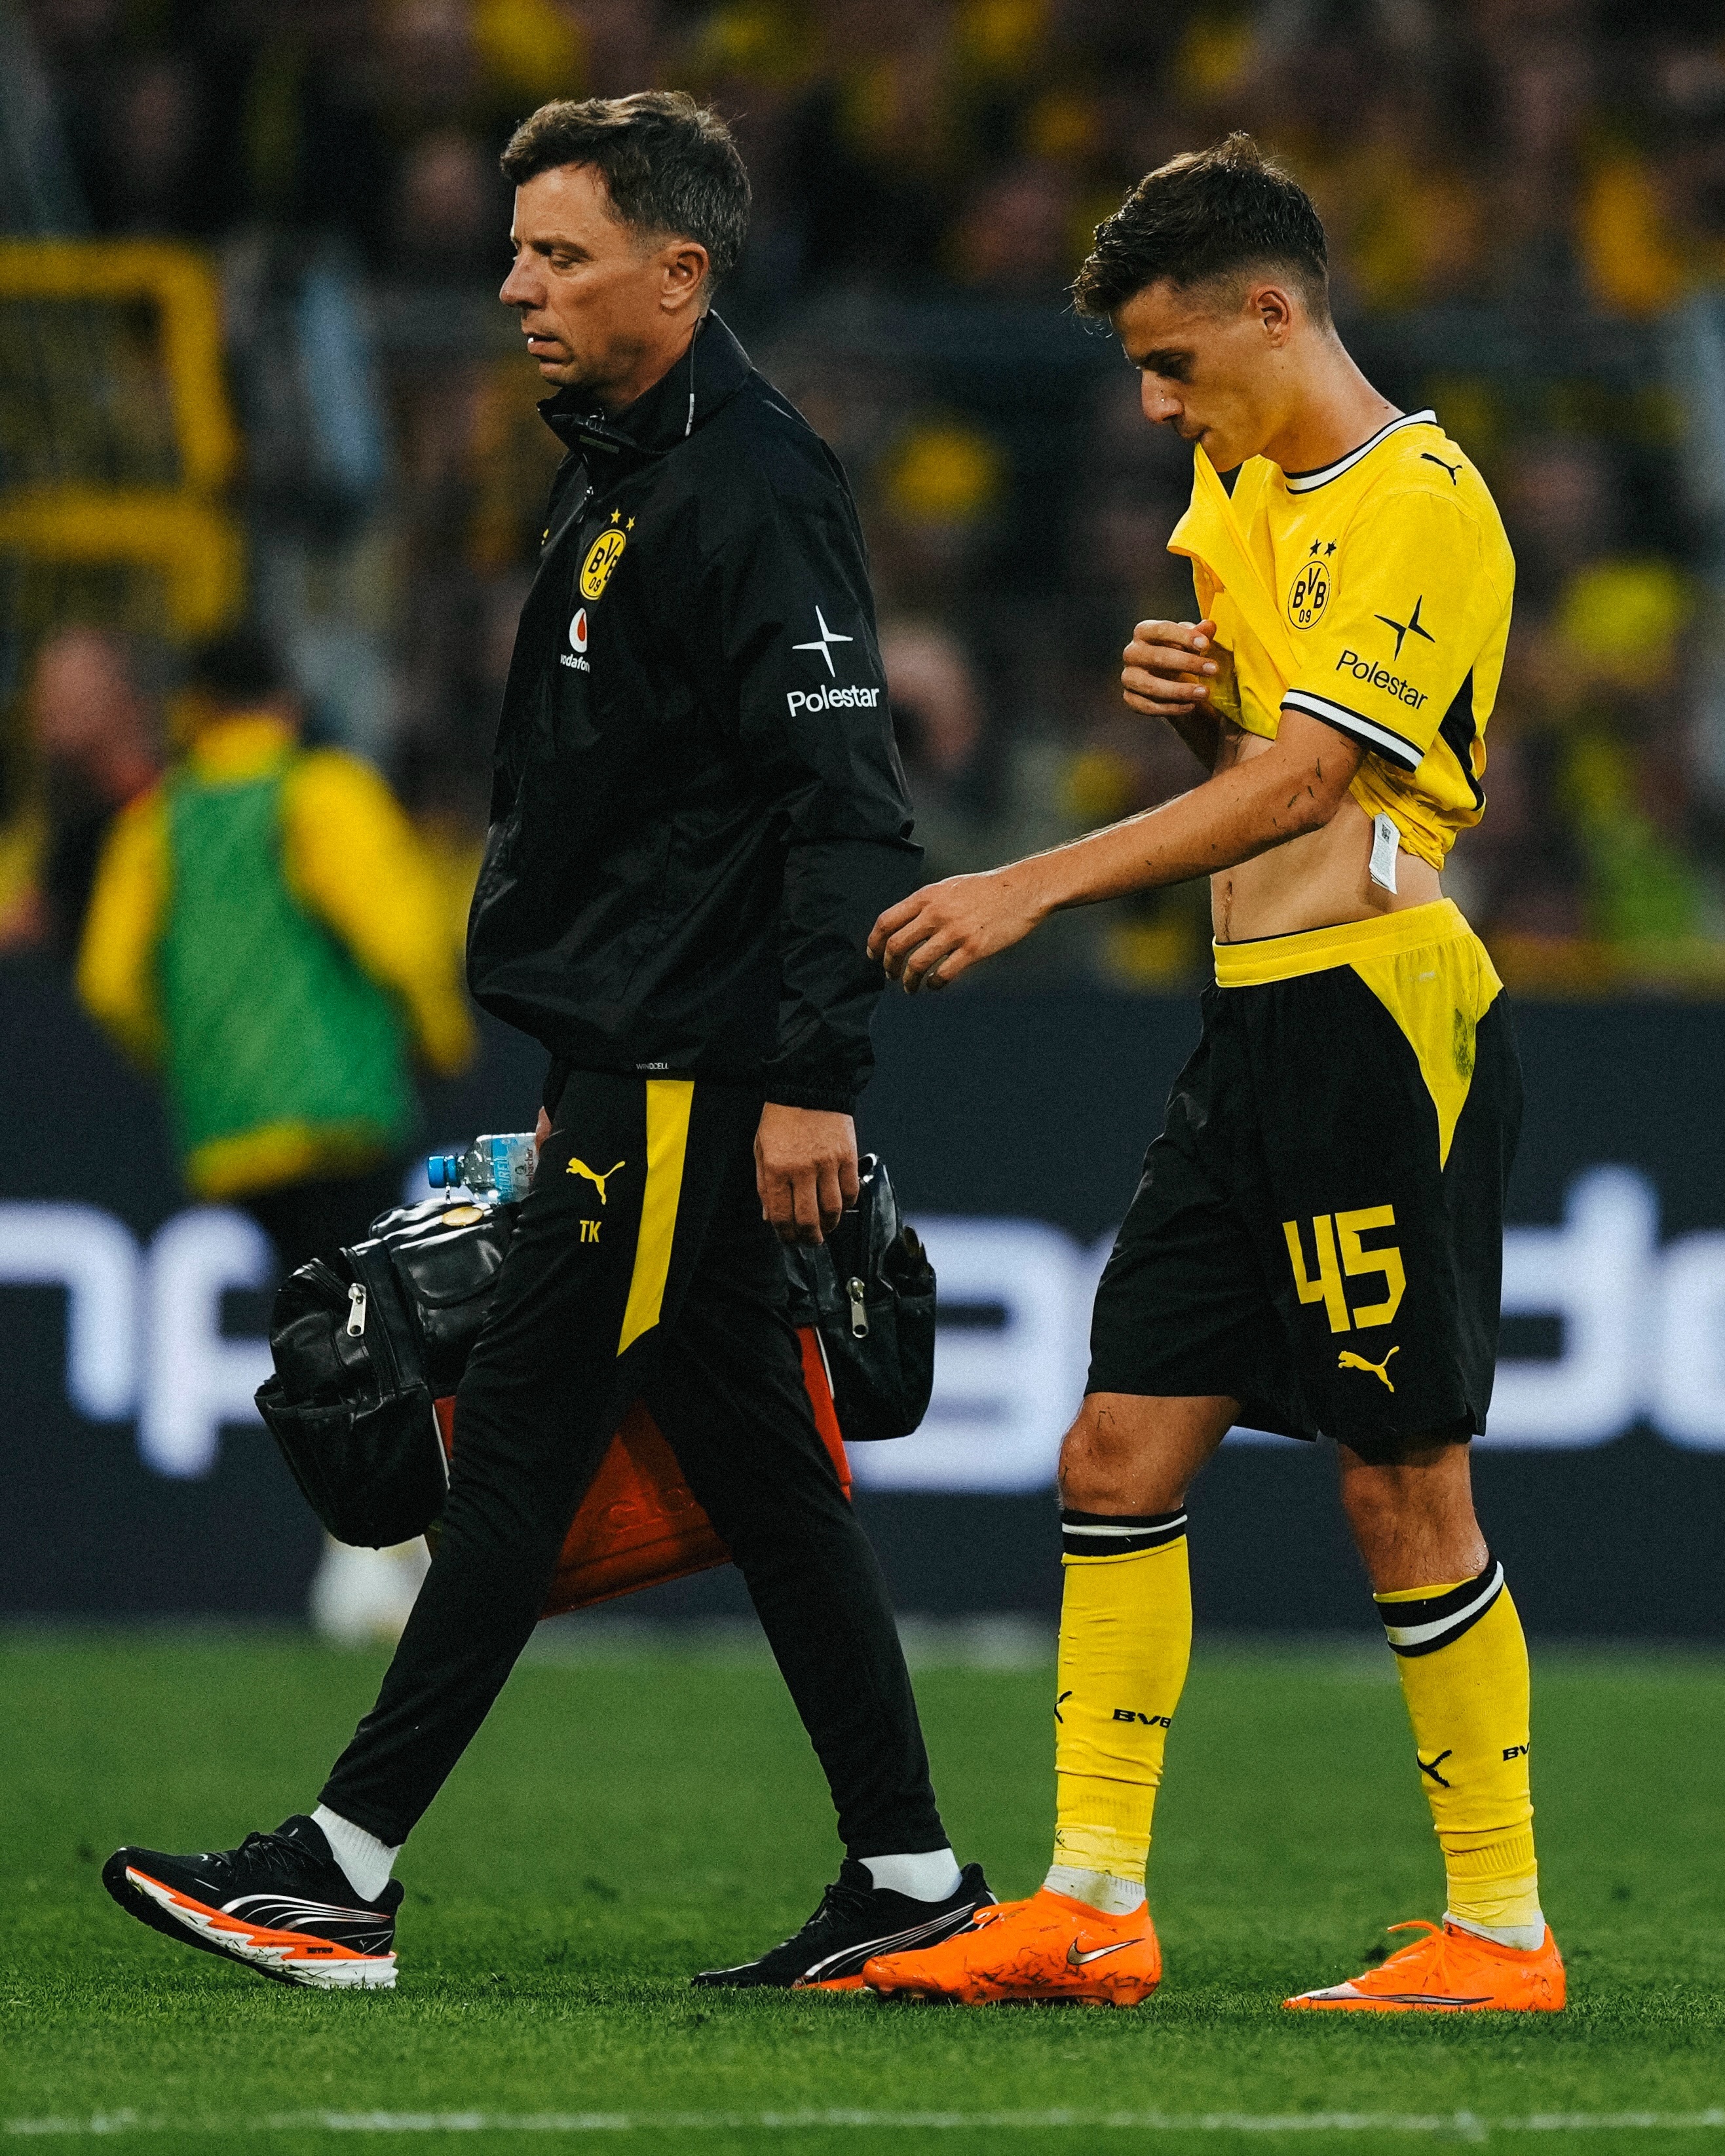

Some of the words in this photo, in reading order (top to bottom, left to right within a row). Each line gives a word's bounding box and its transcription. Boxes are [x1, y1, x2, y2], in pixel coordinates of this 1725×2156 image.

[588, 577, 602, 592] 09
[1292, 567, 1327, 609] BVB
[1298, 609, 1312, 623] 09
[1335, 649, 1429, 710] Polestar
[786, 684, 880, 717] Polestar
[580, 1220, 602, 1243] TK
[1282, 1204, 1407, 1333] 45
[1112, 1709, 1171, 1728] BVB
